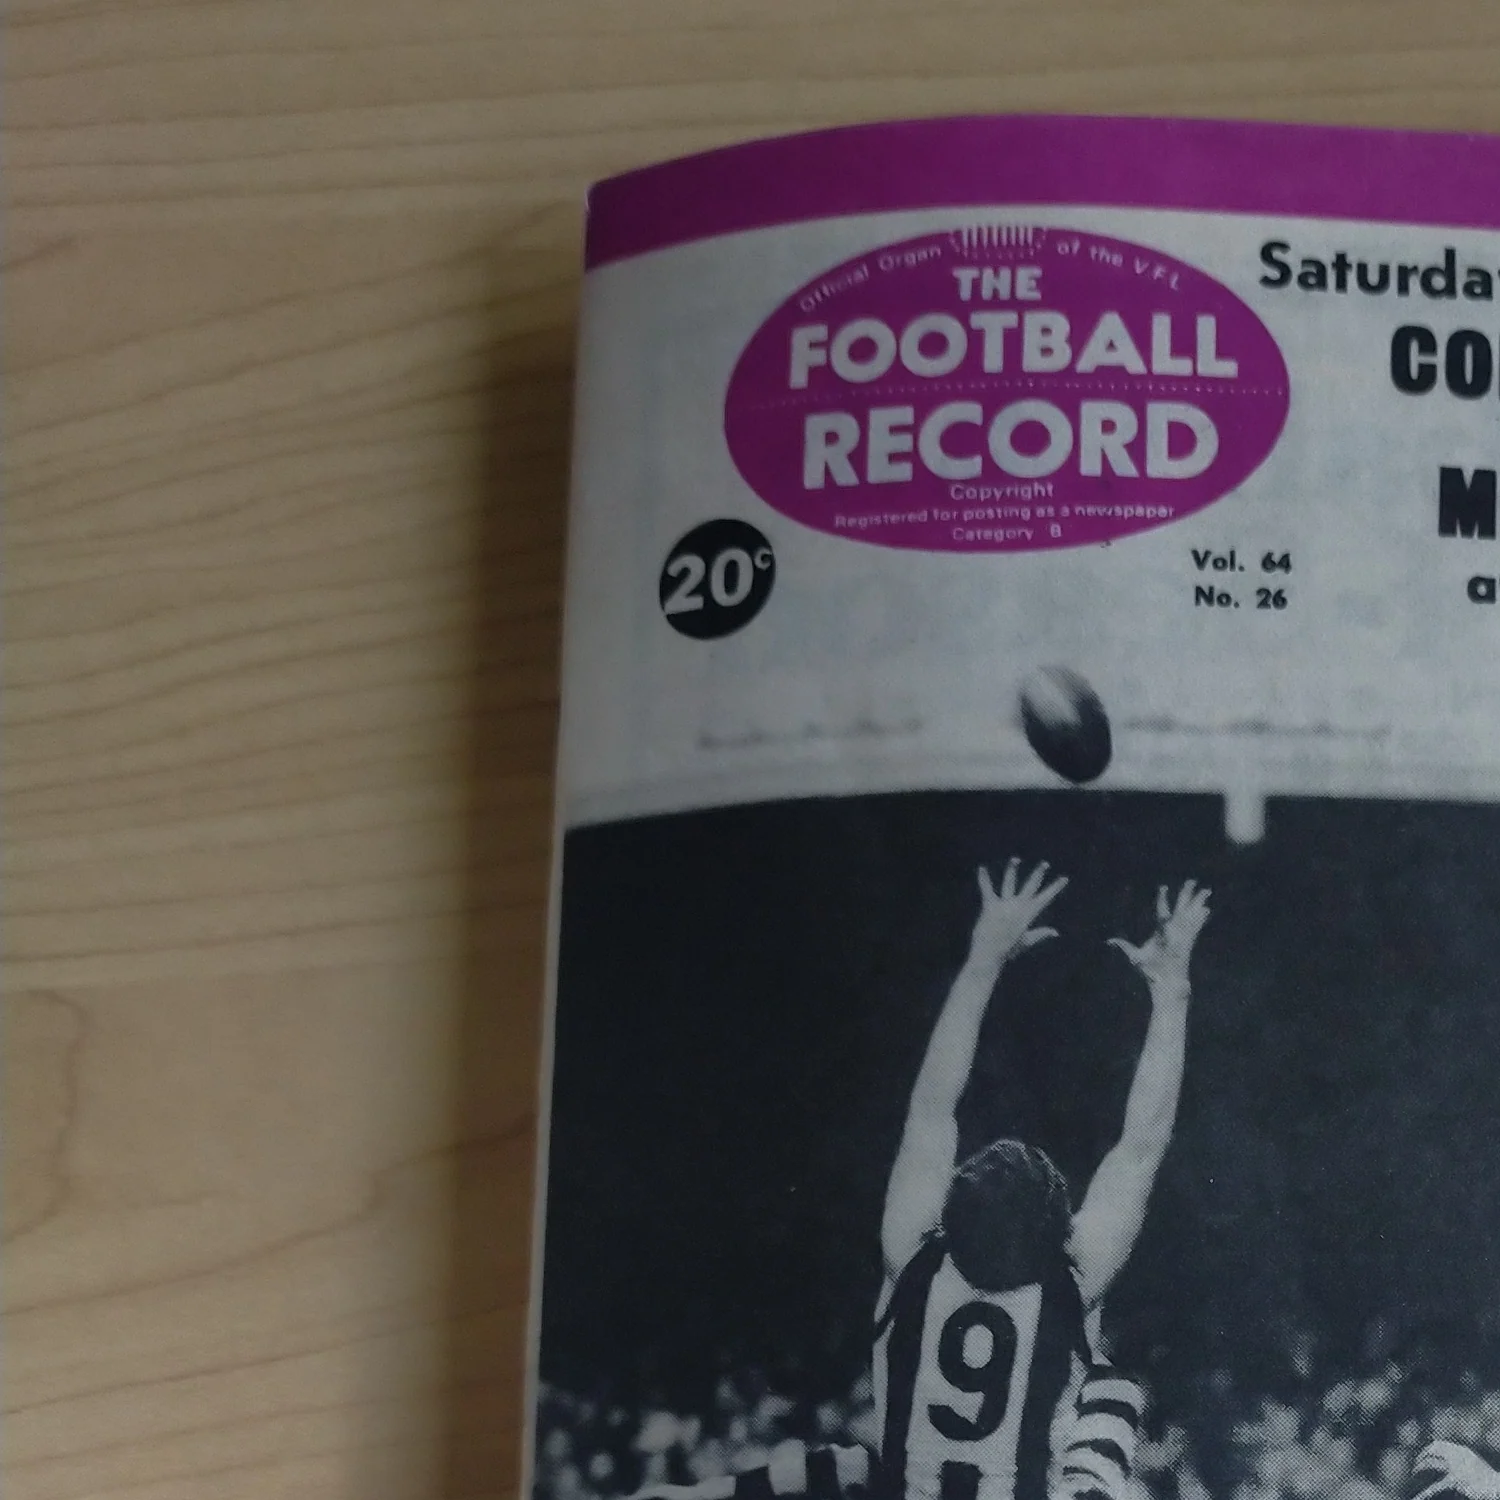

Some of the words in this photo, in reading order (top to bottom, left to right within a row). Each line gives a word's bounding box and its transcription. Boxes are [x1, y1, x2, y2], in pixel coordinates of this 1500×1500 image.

[878, 244, 942, 272] Organ
[1056, 237, 1081, 256] of
[1090, 244, 1123, 268] the
[953, 267, 1042, 300] THE
[791, 311, 1238, 387] FOOTBALL
[803, 399, 1219, 490] RECORD
[950, 482, 1054, 501] Copyright
[835, 511, 929, 530] Registered
[933, 508, 959, 522] for
[963, 504, 1031, 522] posting
[1036, 506, 1056, 519] as
[1061, 505, 1071, 518] a
[1075, 504, 1175, 521] newspaper
[953, 525, 1034, 543] Category
[1191, 549, 1244, 571] Vol.
[1261, 552, 1291, 573] 64
[1195, 586, 1239, 608] No.
[1256, 587, 1287, 609] 26
[927, 1301, 1017, 1442] 9
